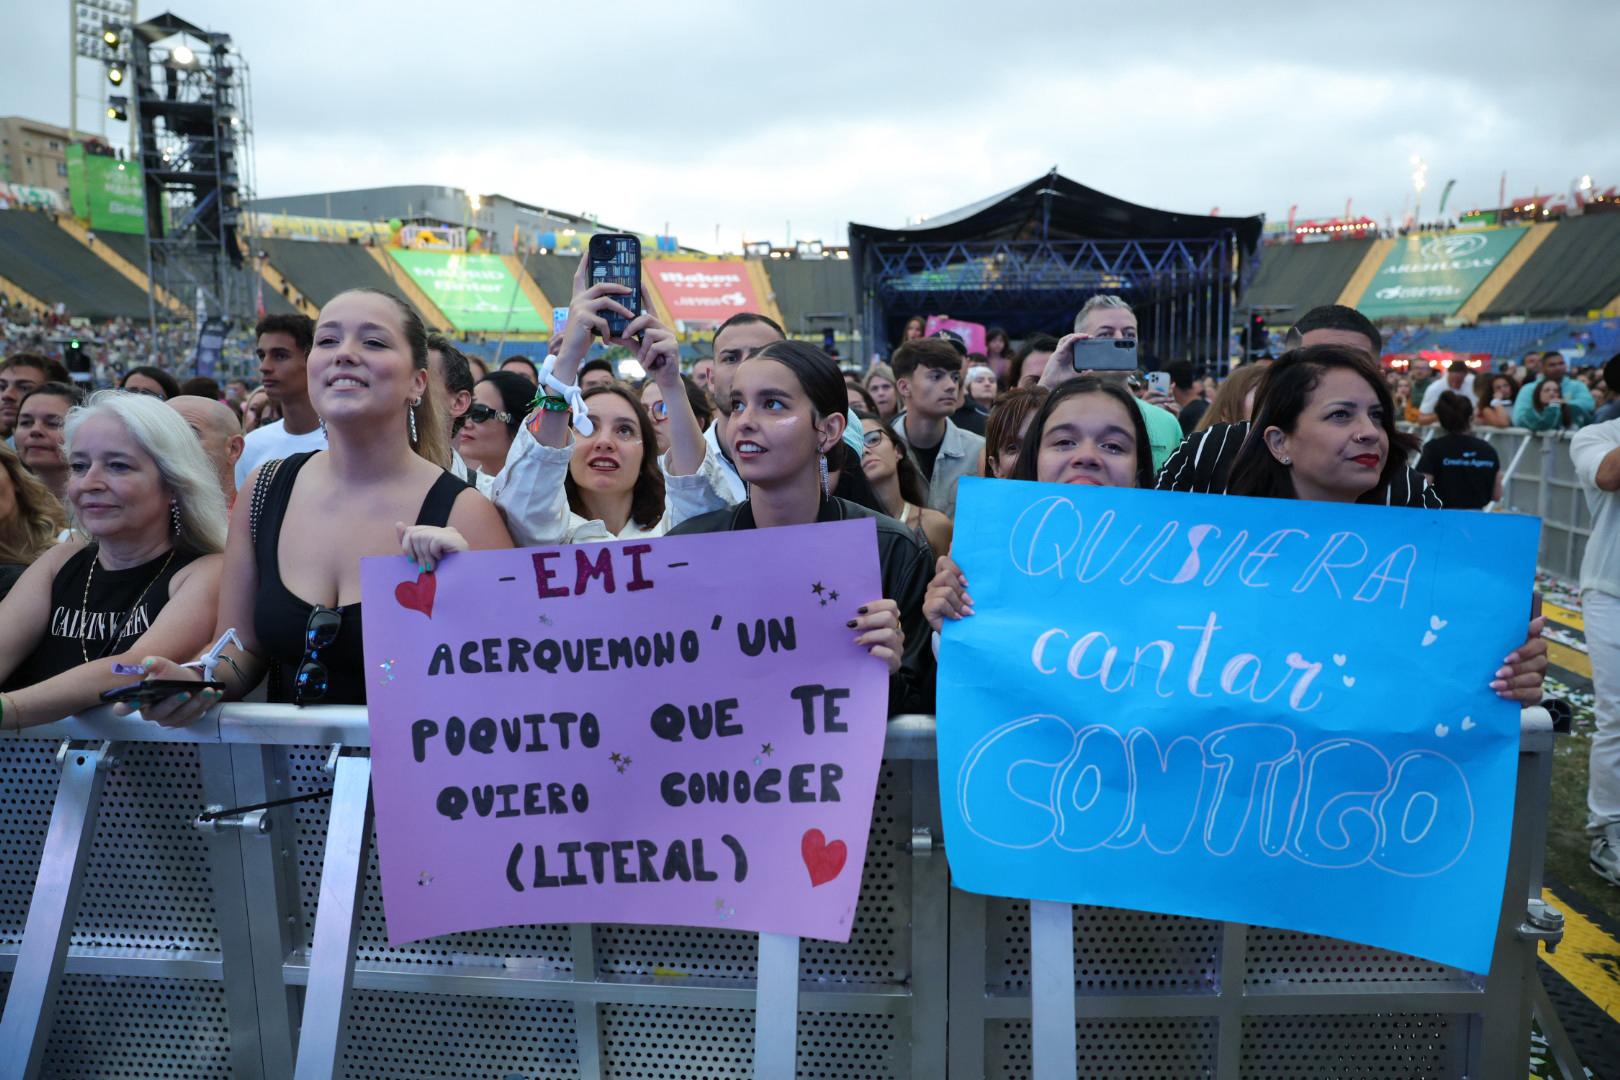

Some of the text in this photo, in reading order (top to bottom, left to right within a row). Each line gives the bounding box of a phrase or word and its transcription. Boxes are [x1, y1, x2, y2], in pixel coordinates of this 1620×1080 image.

[1010, 496, 1417, 609] QUISIERA
[51, 606, 107, 640] CALVIN
[1031, 612, 1322, 711] cantar
[411, 684, 850, 763] POQUITO QUE TE
[436, 763, 843, 821] QUIERO CONOCER
[958, 714, 1474, 877] CONTIGO
[505, 834, 748, 893] (LITERAL)
